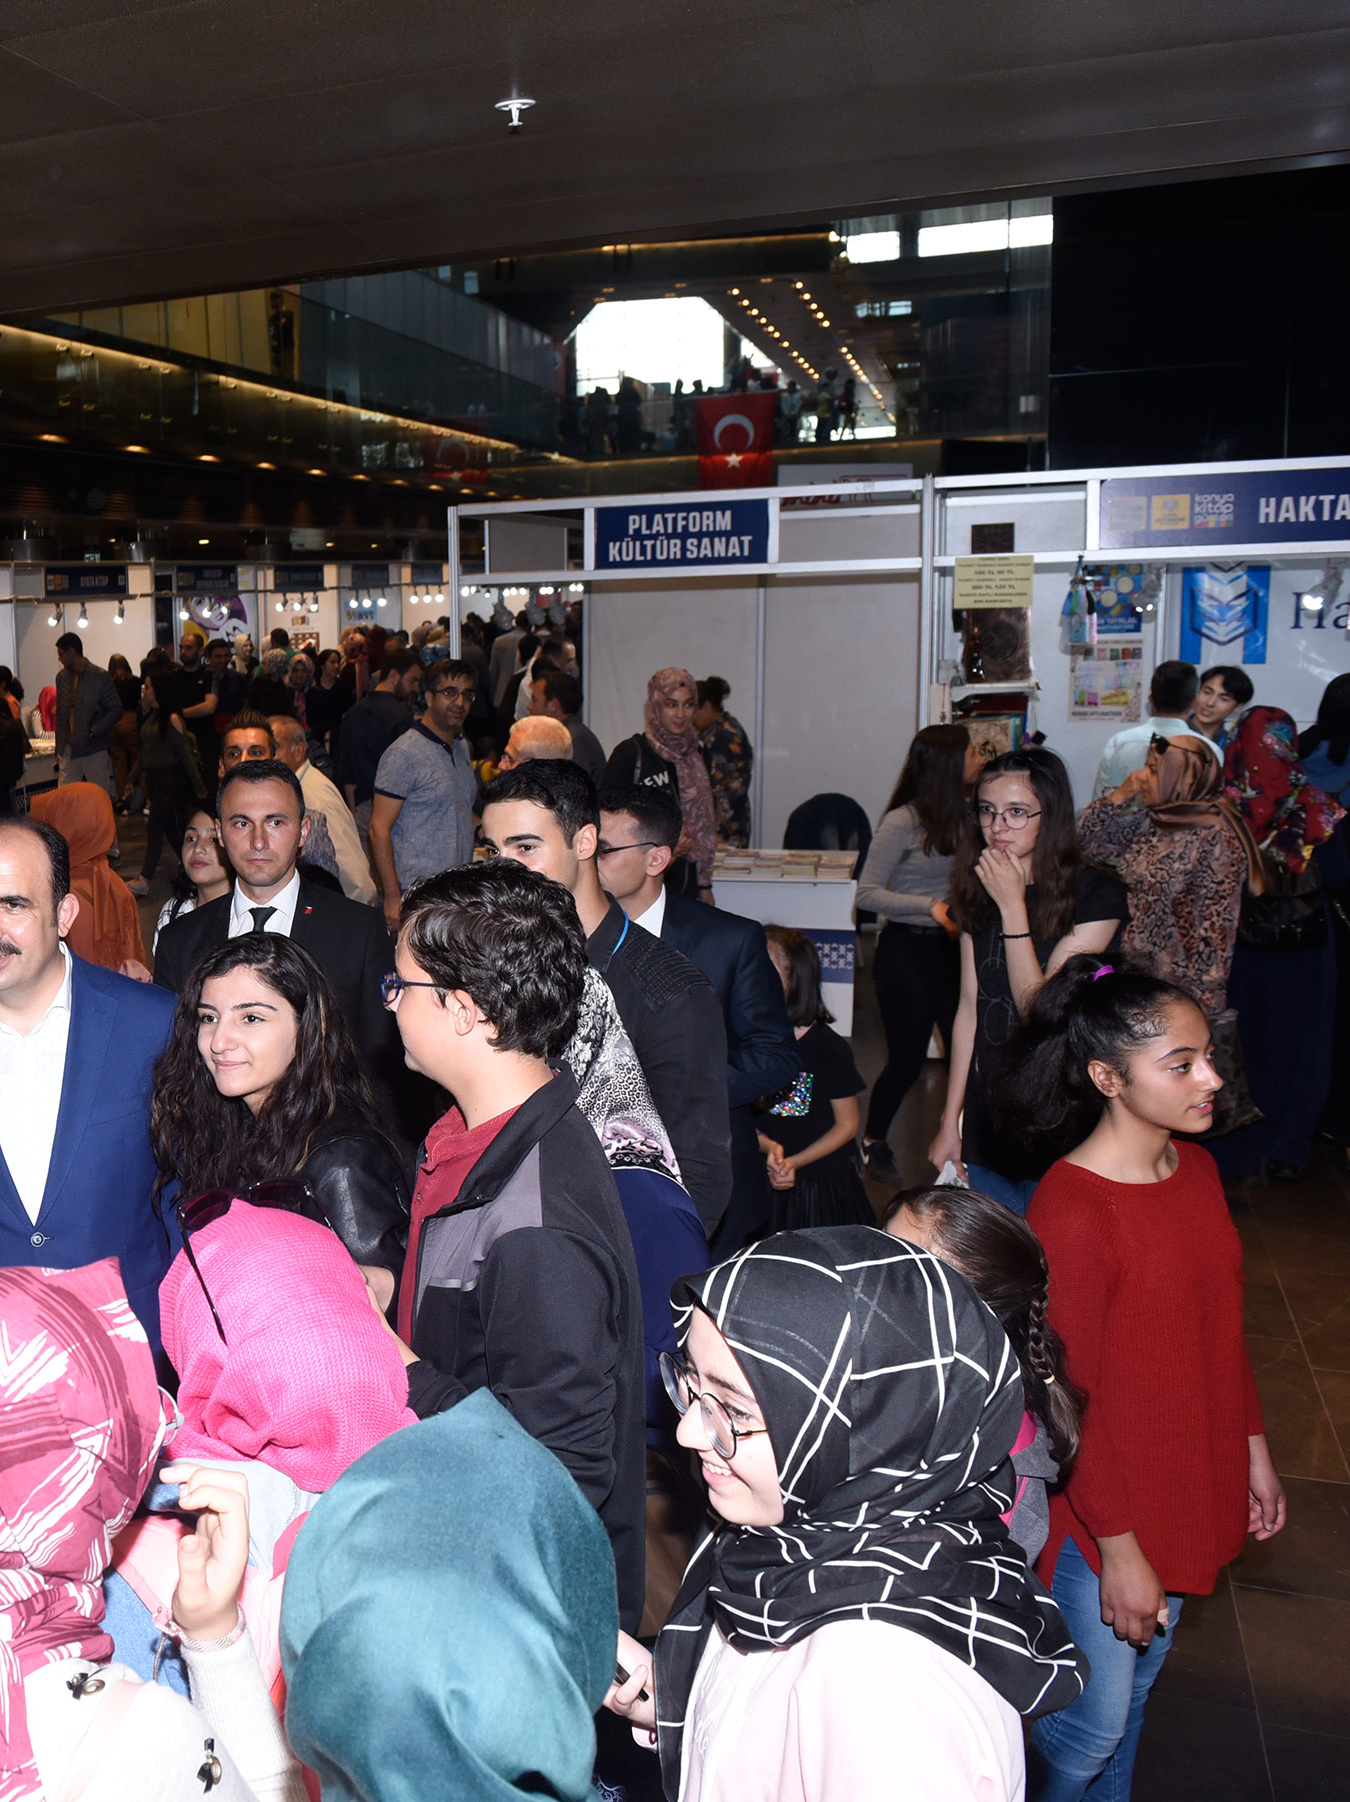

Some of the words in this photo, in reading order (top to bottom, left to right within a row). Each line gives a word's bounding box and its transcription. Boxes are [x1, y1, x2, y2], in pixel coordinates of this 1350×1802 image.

[628, 509, 732, 536] PLATFORM
[608, 536, 682, 563] KÜLTÜR
[686, 535, 753, 560] SANAT
